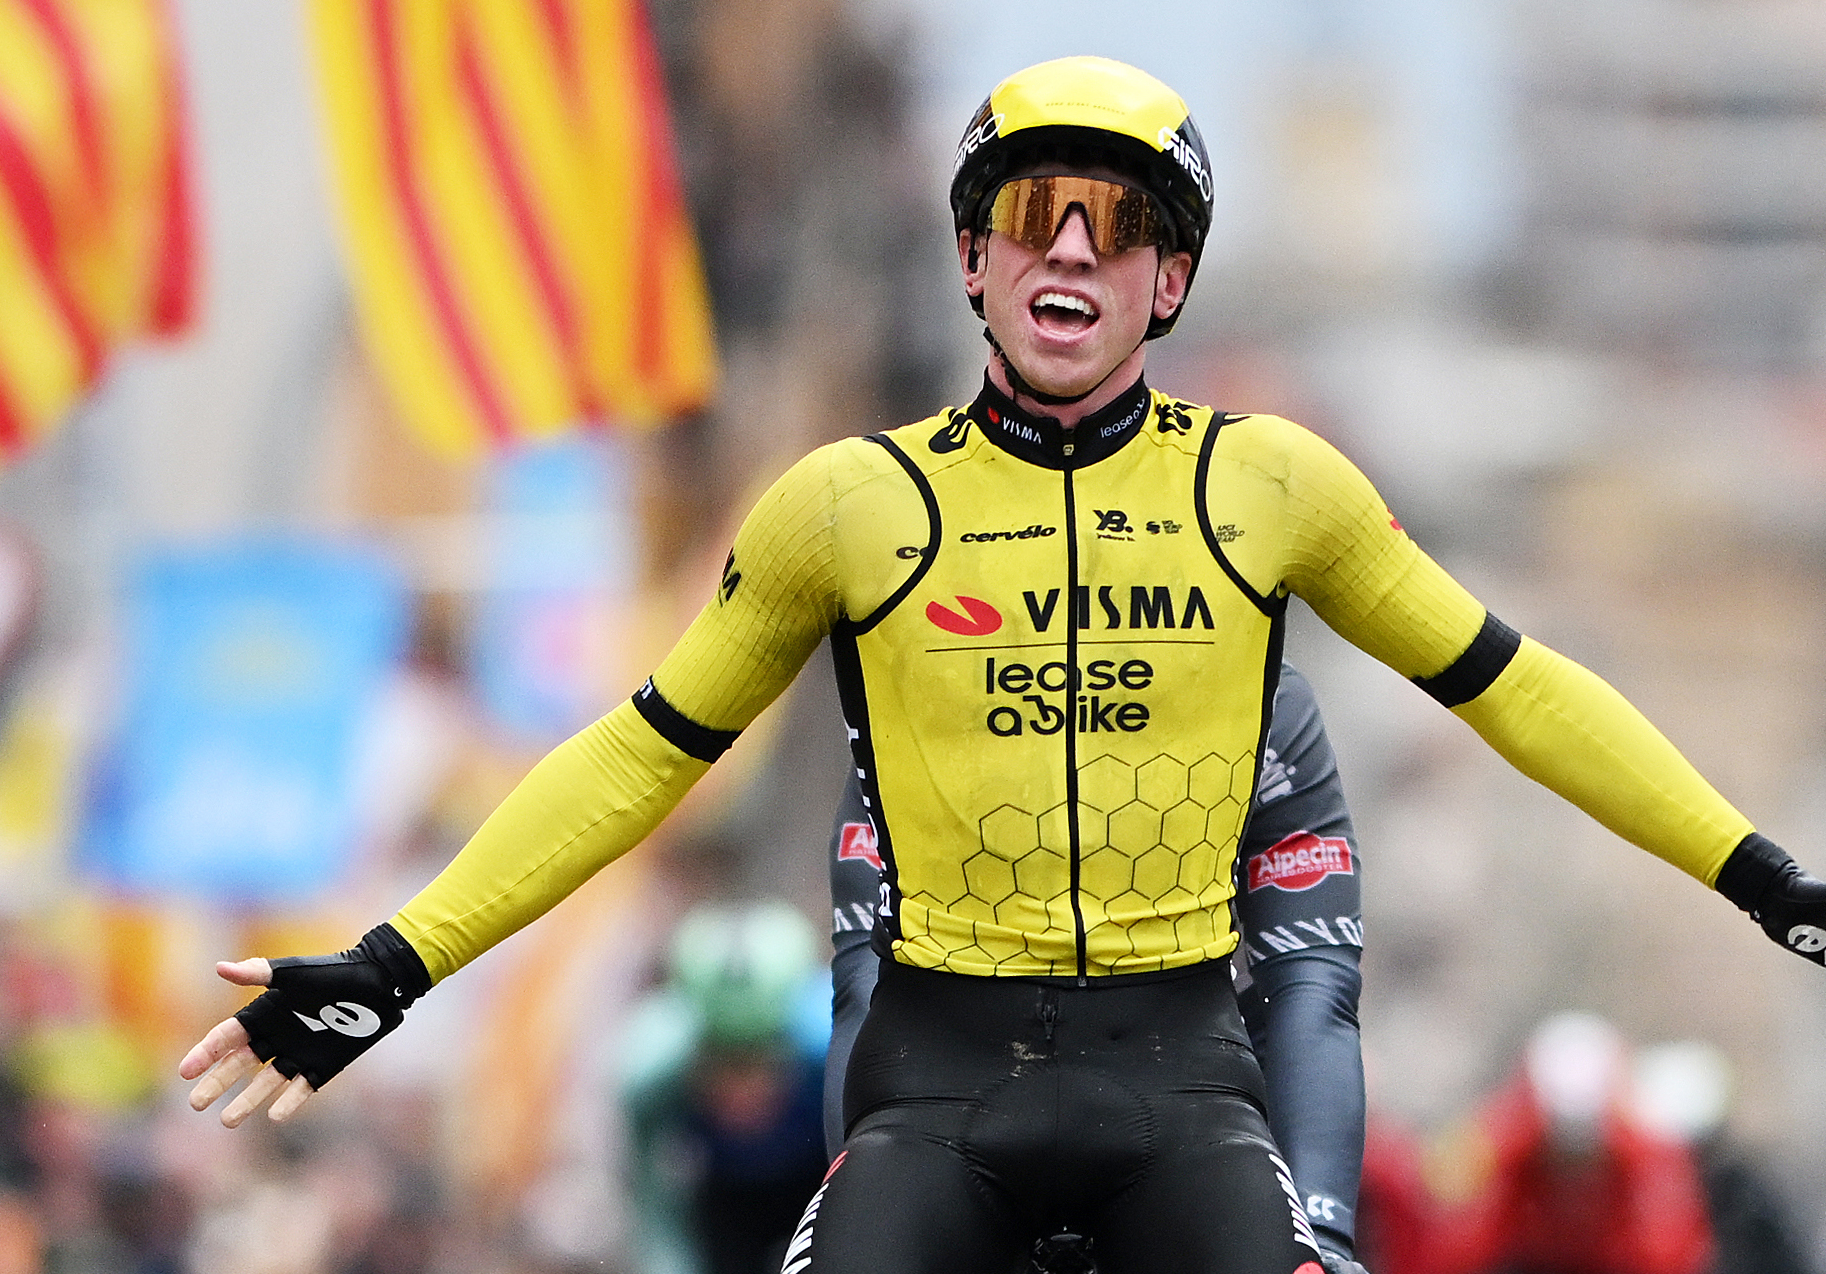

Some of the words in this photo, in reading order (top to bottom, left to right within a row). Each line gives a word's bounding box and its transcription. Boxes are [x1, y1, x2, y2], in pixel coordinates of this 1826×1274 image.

[1158, 126, 1211, 202] GIRO
[1002, 416, 1042, 445] VISMA
[959, 525, 1057, 543] cervélo
[1023, 586, 1215, 632] VISMA
[986, 658, 1154, 694] lease
[1258, 842, 1341, 879] Alpecin
